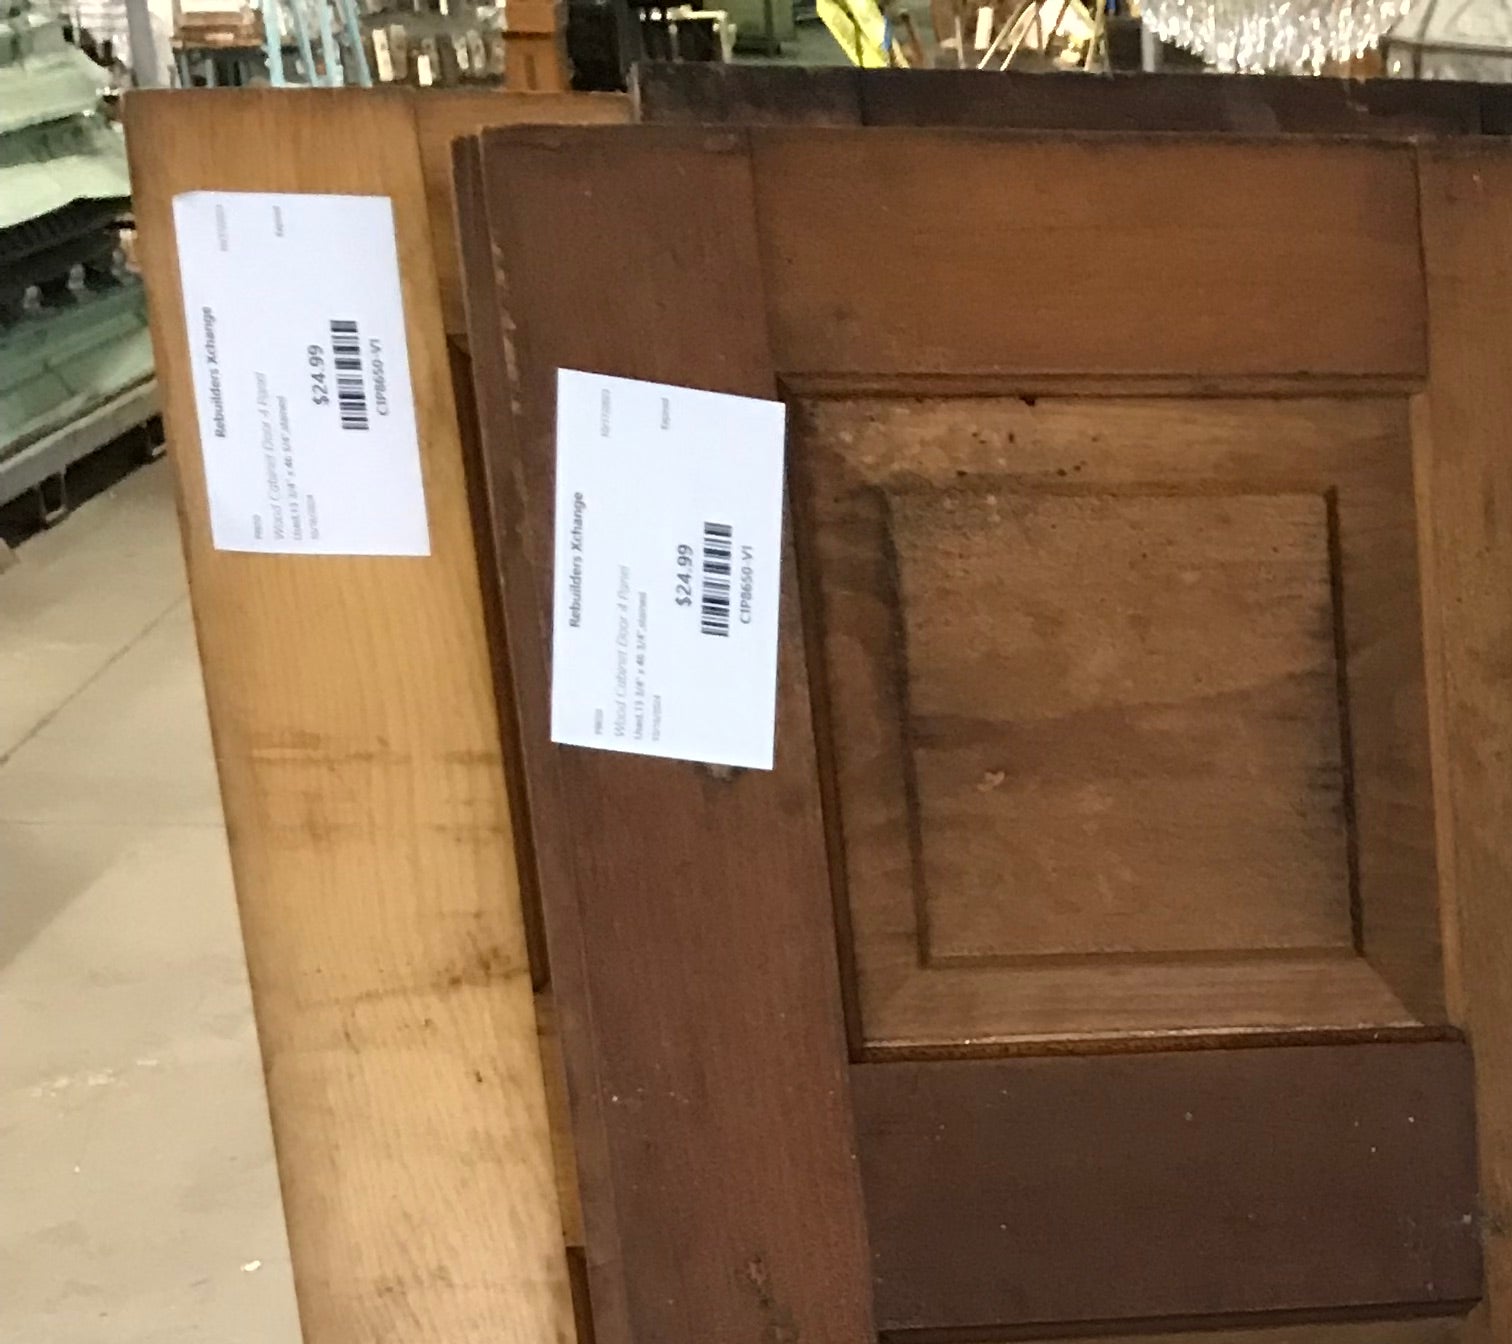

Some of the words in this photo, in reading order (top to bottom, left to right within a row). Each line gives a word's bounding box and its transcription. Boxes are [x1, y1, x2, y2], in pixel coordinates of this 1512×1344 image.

[200, 306, 221, 364] Xchange
[207, 368, 226, 437] Rebuilders
[305, 344, 329, 405] $24.99
[570, 490, 586, 552] Xchange
[568, 554, 581, 627] Rebuilders
[674, 542, 693, 607] $24.99
[615, 615, 628, 646] Door
[614, 700, 626, 737] Wood
